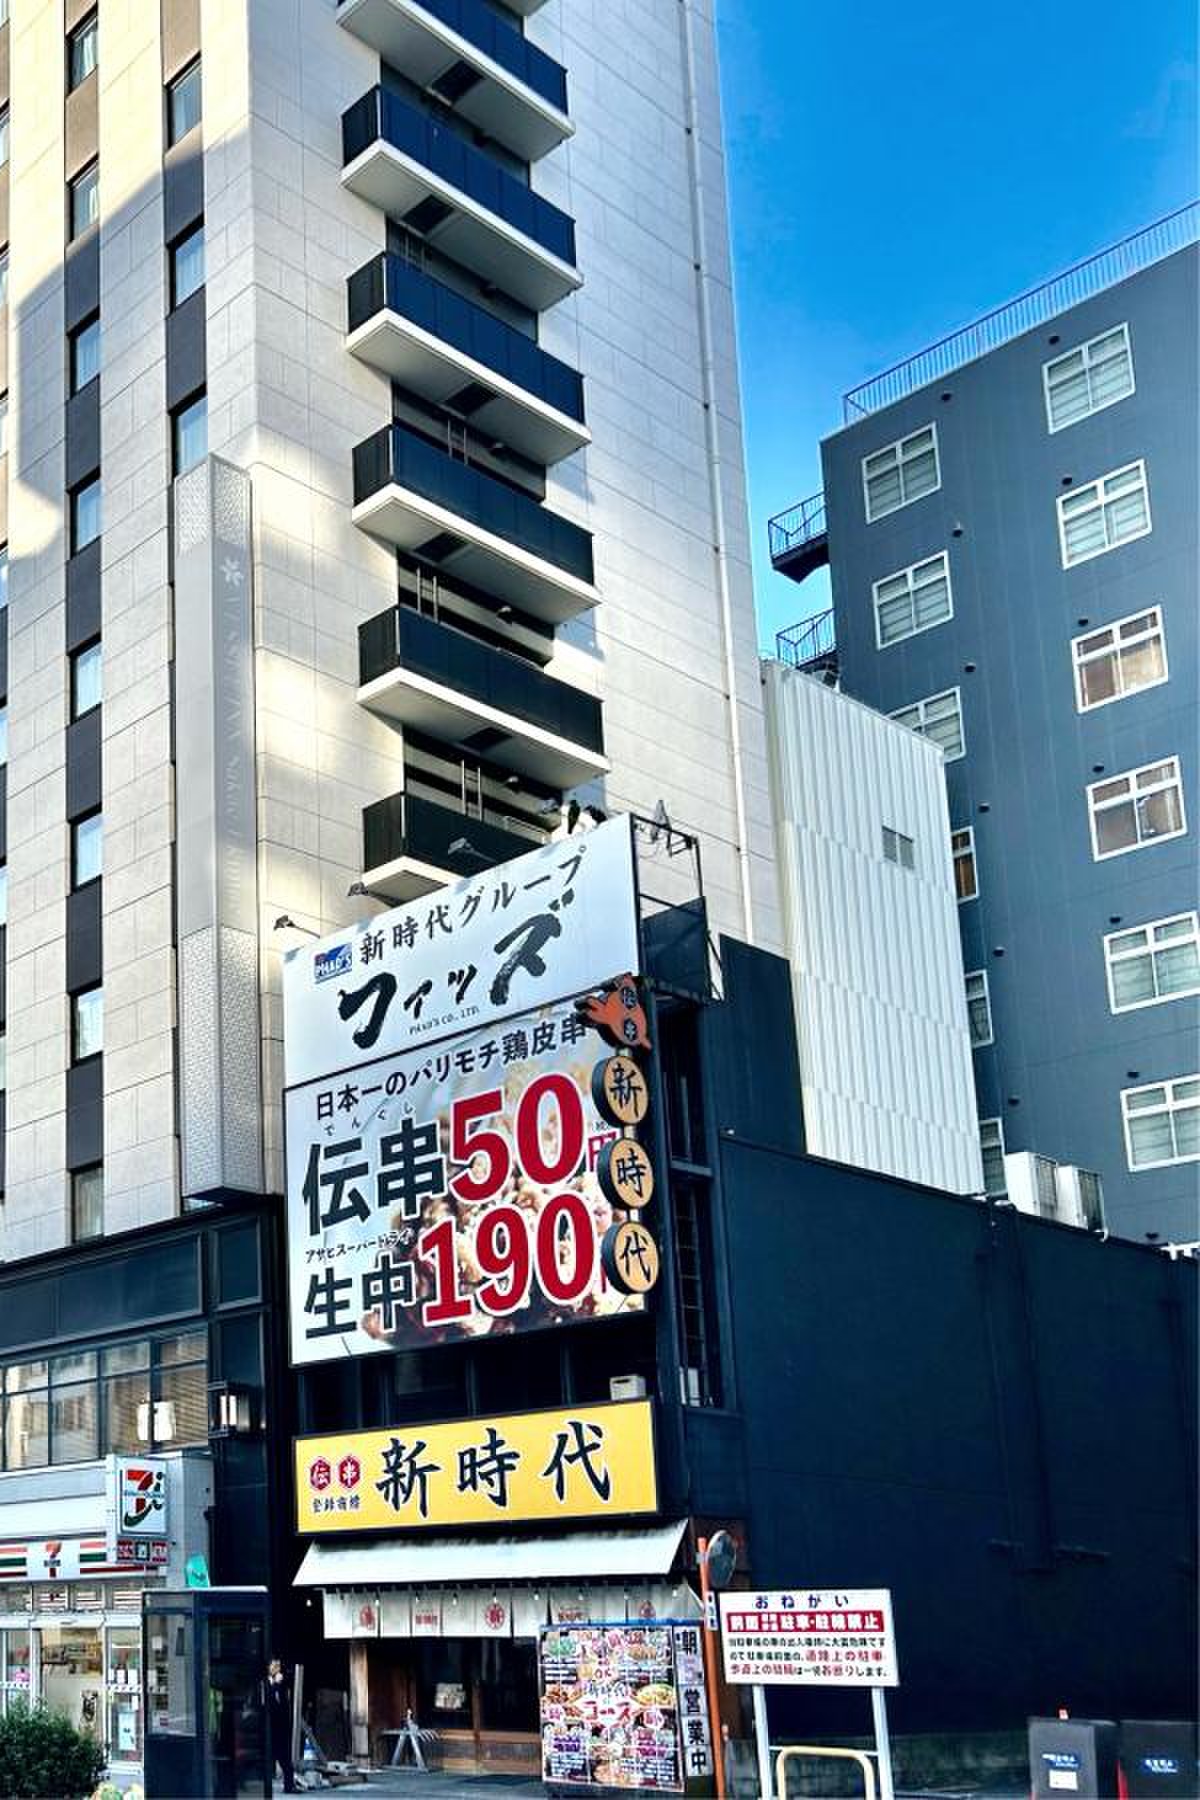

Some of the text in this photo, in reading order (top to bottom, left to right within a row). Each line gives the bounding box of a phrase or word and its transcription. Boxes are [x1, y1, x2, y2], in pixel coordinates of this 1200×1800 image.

[360, 845, 587, 965] 新時代グループ
[317, 1011, 587, 1121] 日本一のパリモチ鶏皮串
[303, 1118, 445, 1236] 伝串
[451, 1074, 584, 1201] 50
[609, 1062, 651, 1282] 新時代
[303, 1193, 595, 1339] 生中 190
[375, 1420, 612, 1518] 新時代
[755, 1594, 849, 1609] おねがい
[684, 1688, 707, 1775] 営業中
